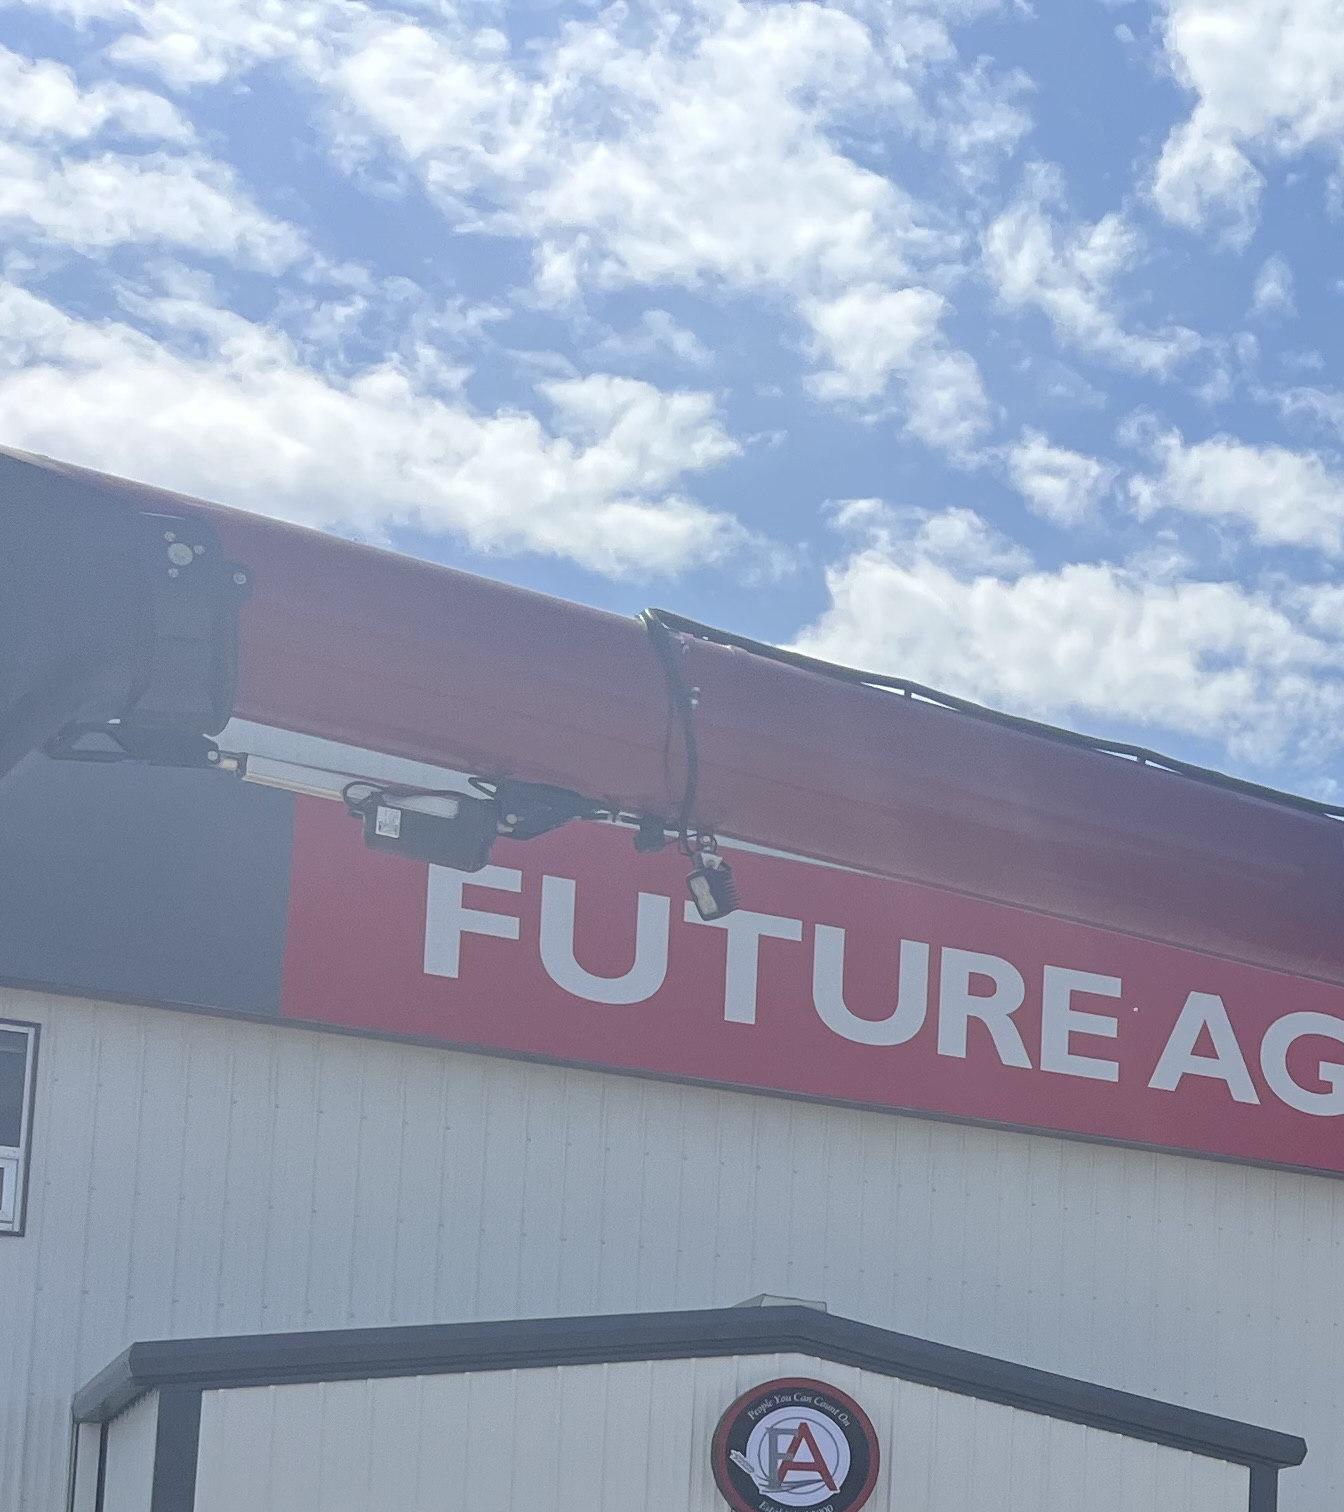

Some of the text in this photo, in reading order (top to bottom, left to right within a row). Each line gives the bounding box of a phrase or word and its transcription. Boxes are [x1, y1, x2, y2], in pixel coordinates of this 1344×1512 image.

[423, 863, 1122, 1082] FUTURE
[747, 1392, 851, 1427] People You Can Count On
